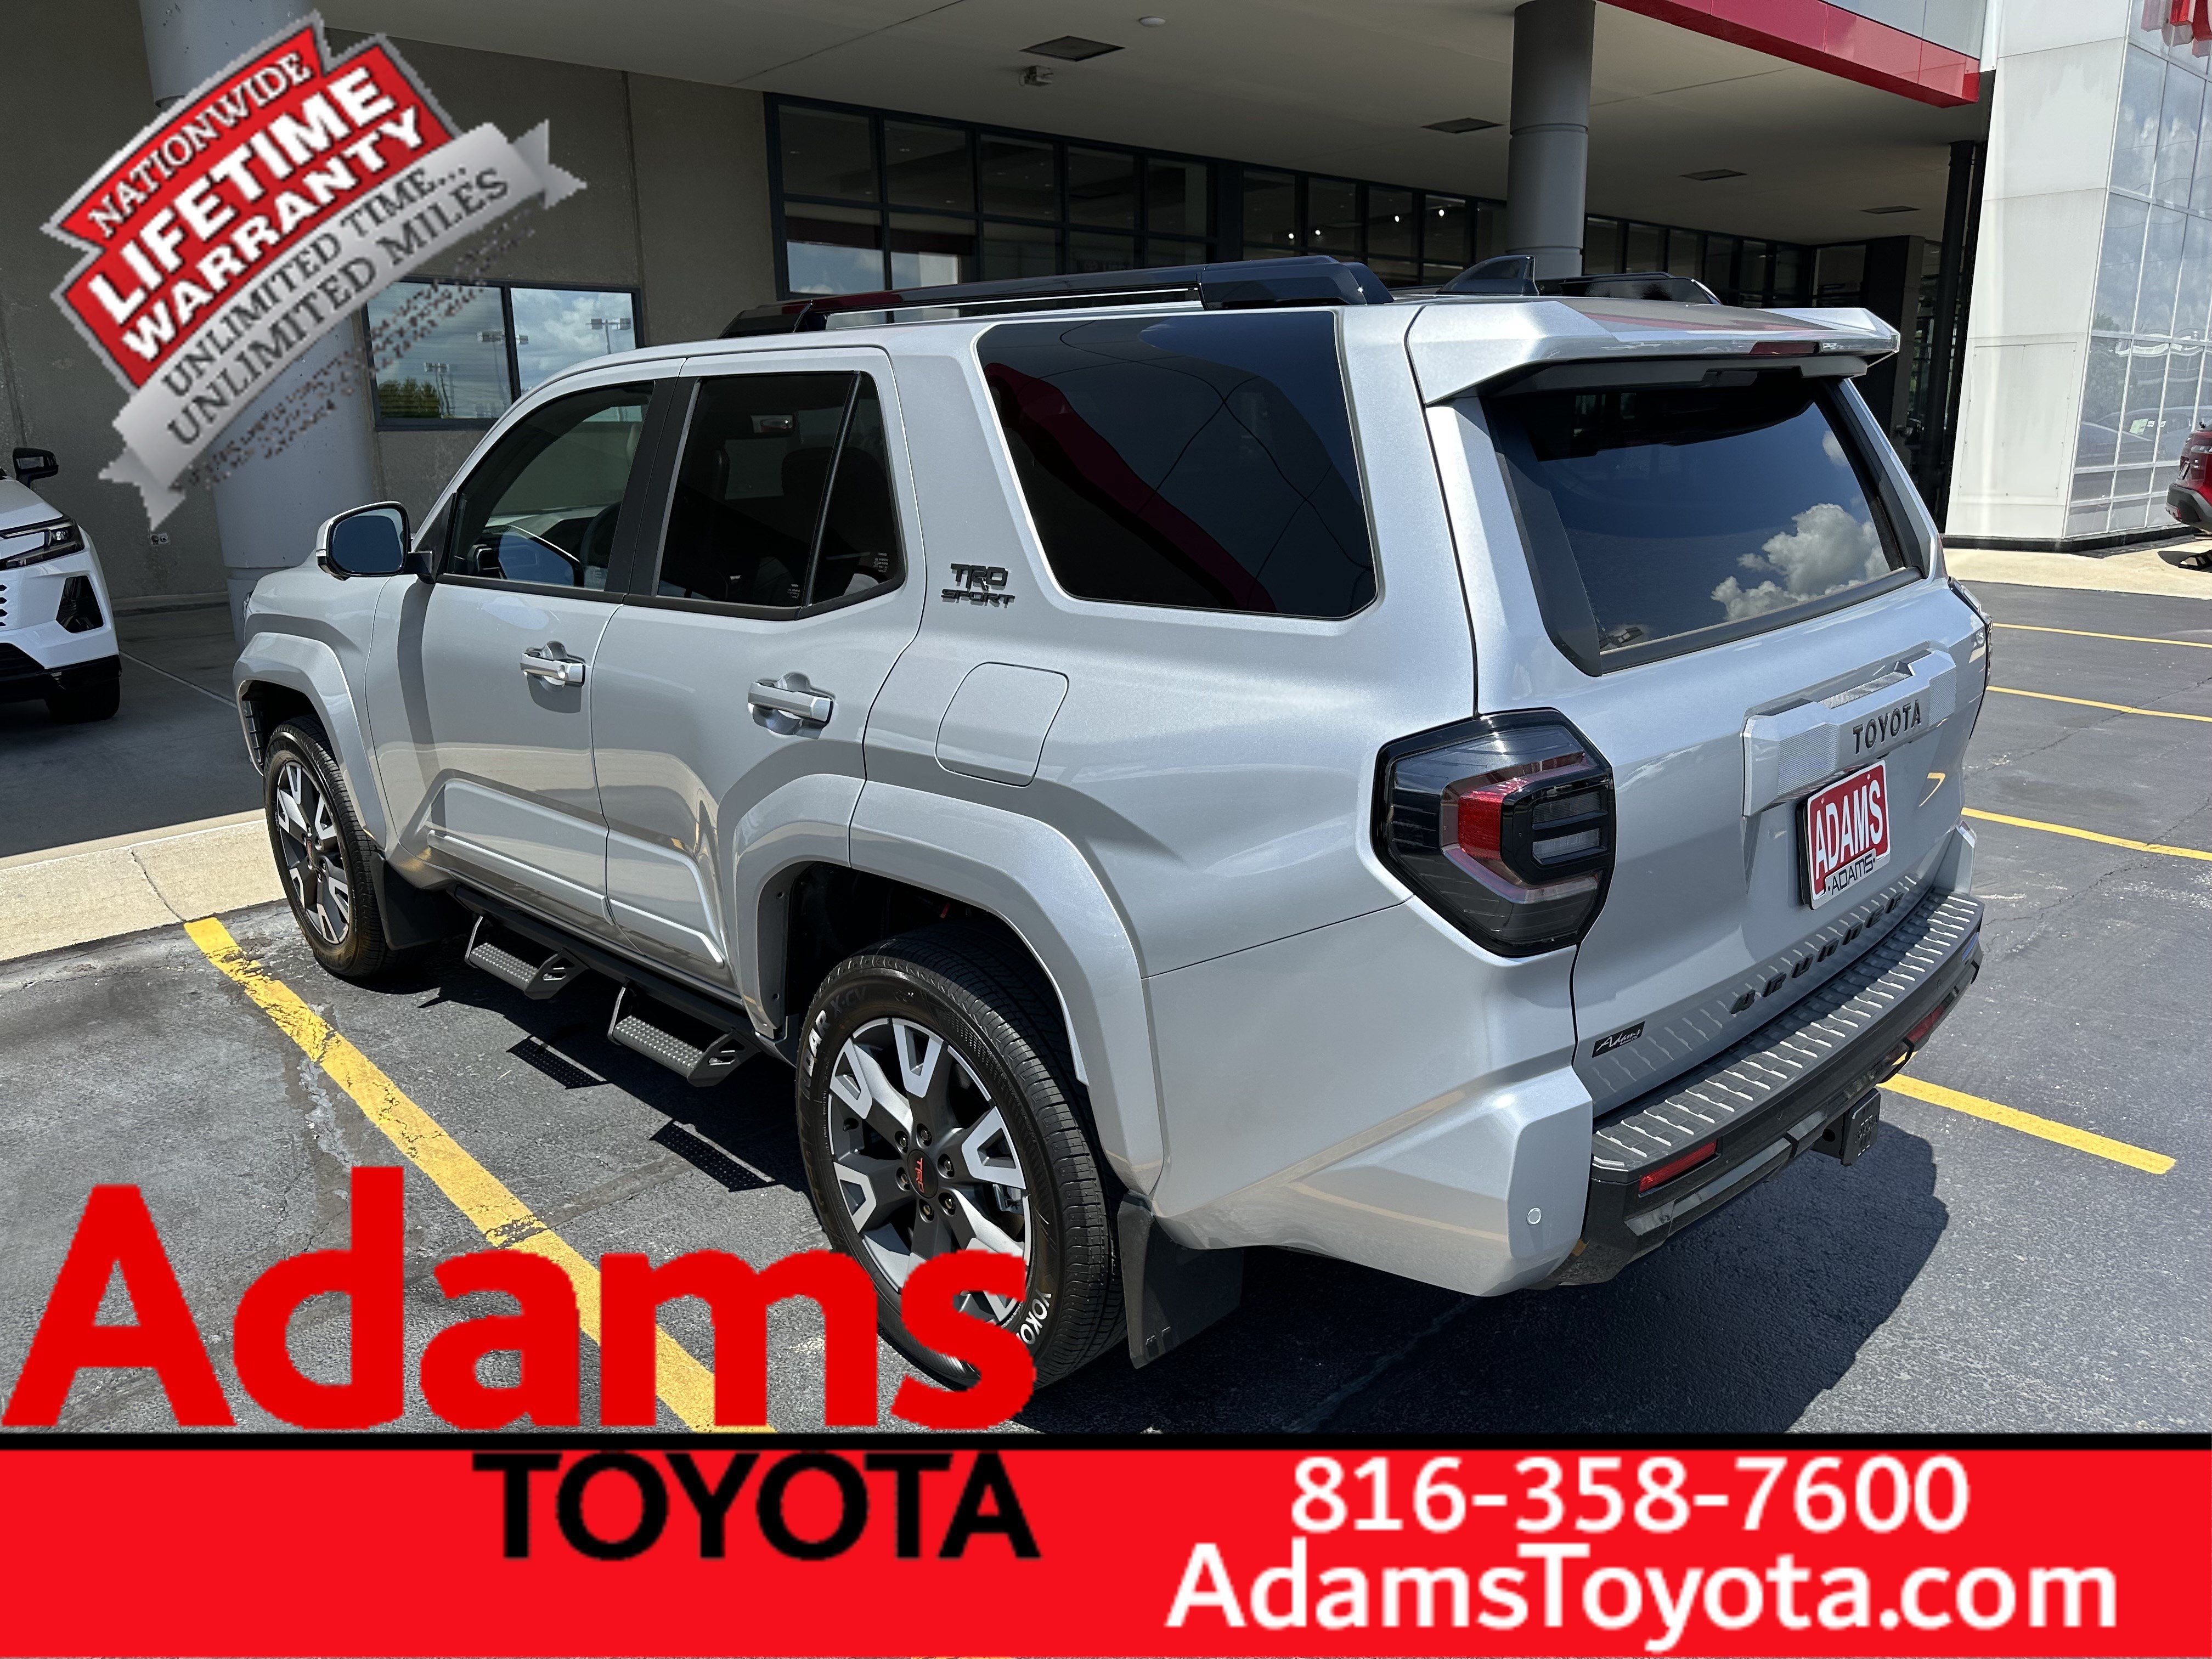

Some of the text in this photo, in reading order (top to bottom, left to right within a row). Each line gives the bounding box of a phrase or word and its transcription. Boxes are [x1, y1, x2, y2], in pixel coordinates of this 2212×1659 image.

[941, 589, 1015, 605] SPORT
[950, 563, 1008, 591] TRD
[1853, 699, 1921, 754] TOYOTA
[1815, 780, 1883, 881] ADAMS
[1831, 853, 1873, 896] ADAMS
[1730, 891, 1904, 1014] 4RUNNER
[1595, 1029, 1640, 1052] Adams
[914, 1156, 926, 1194] TRD
[1015, 1288, 1052, 1345] YOKO
